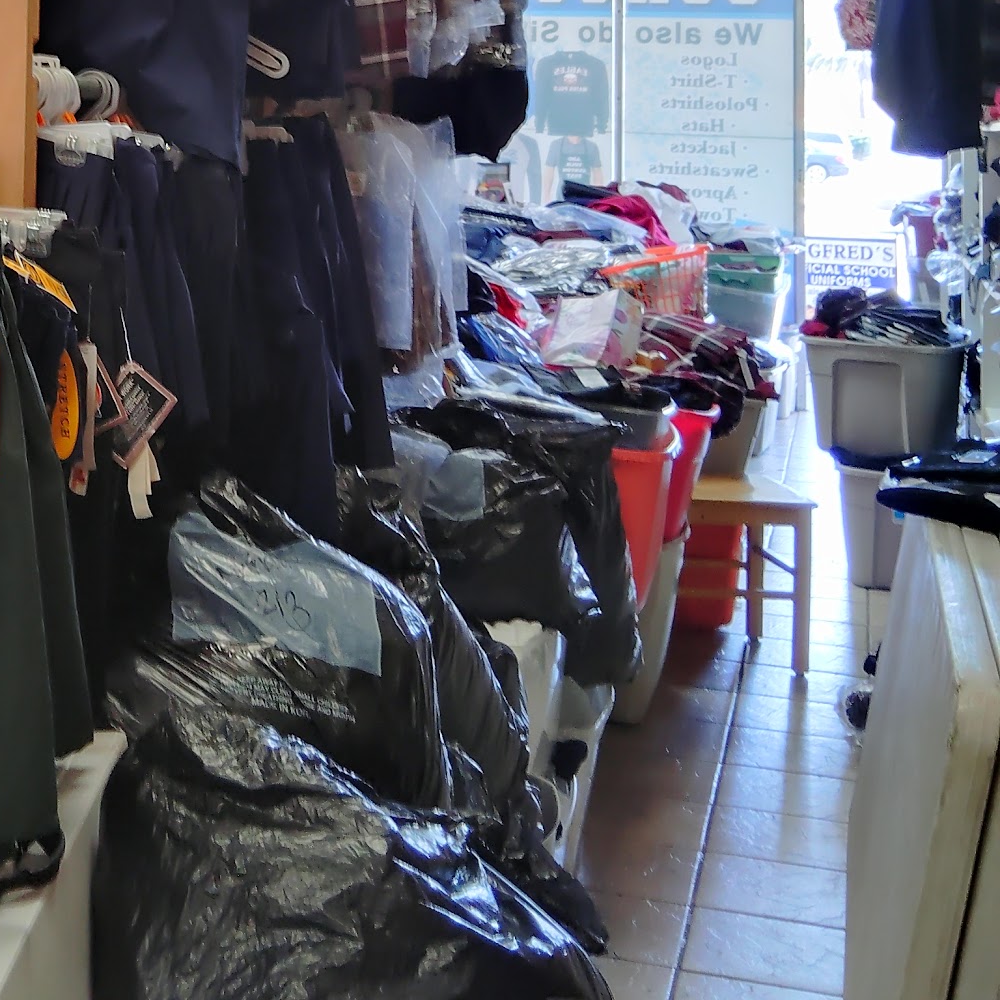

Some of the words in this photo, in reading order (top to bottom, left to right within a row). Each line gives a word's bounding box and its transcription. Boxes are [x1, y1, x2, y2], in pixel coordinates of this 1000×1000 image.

[843, 265, 896, 278] SCHOOL
[810, 275, 872, 288] UNIFORMS
[59, 363, 70, 440] TRETCH
